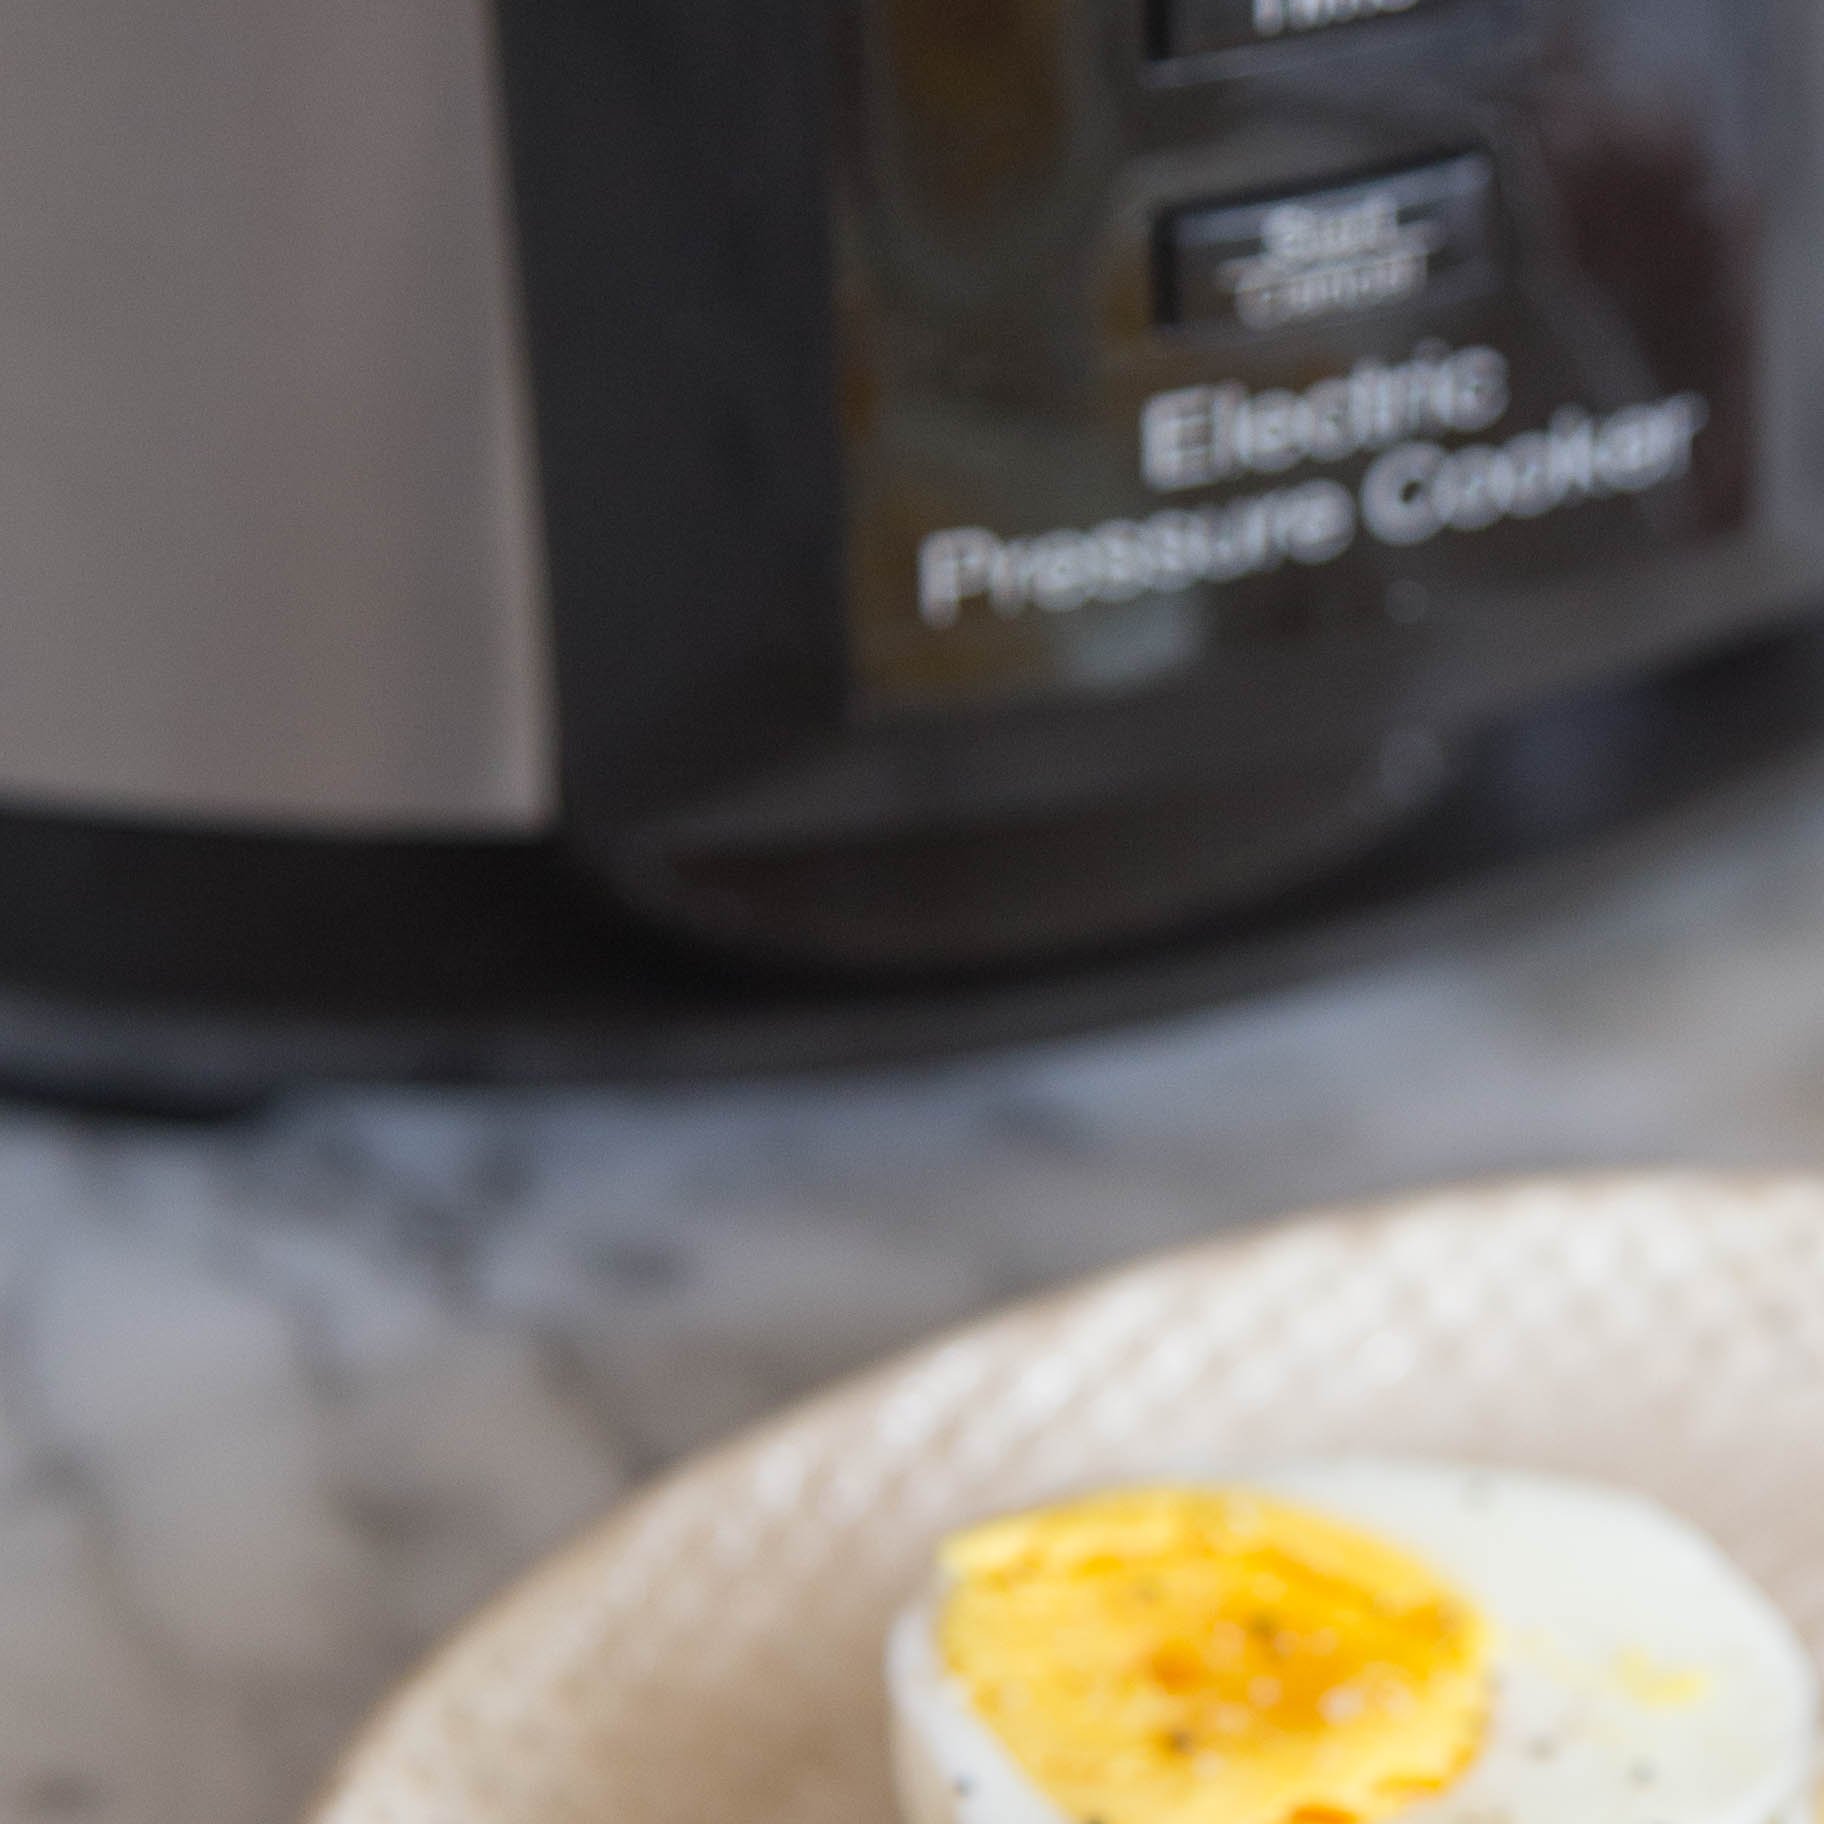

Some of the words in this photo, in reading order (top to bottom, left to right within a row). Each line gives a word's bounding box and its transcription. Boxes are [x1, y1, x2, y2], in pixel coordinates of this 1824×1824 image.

[920, 480, 1356, 628] Pressure
[1361, 391, 1709, 546] Cooker
[1142, 338, 1508, 491] Electric
